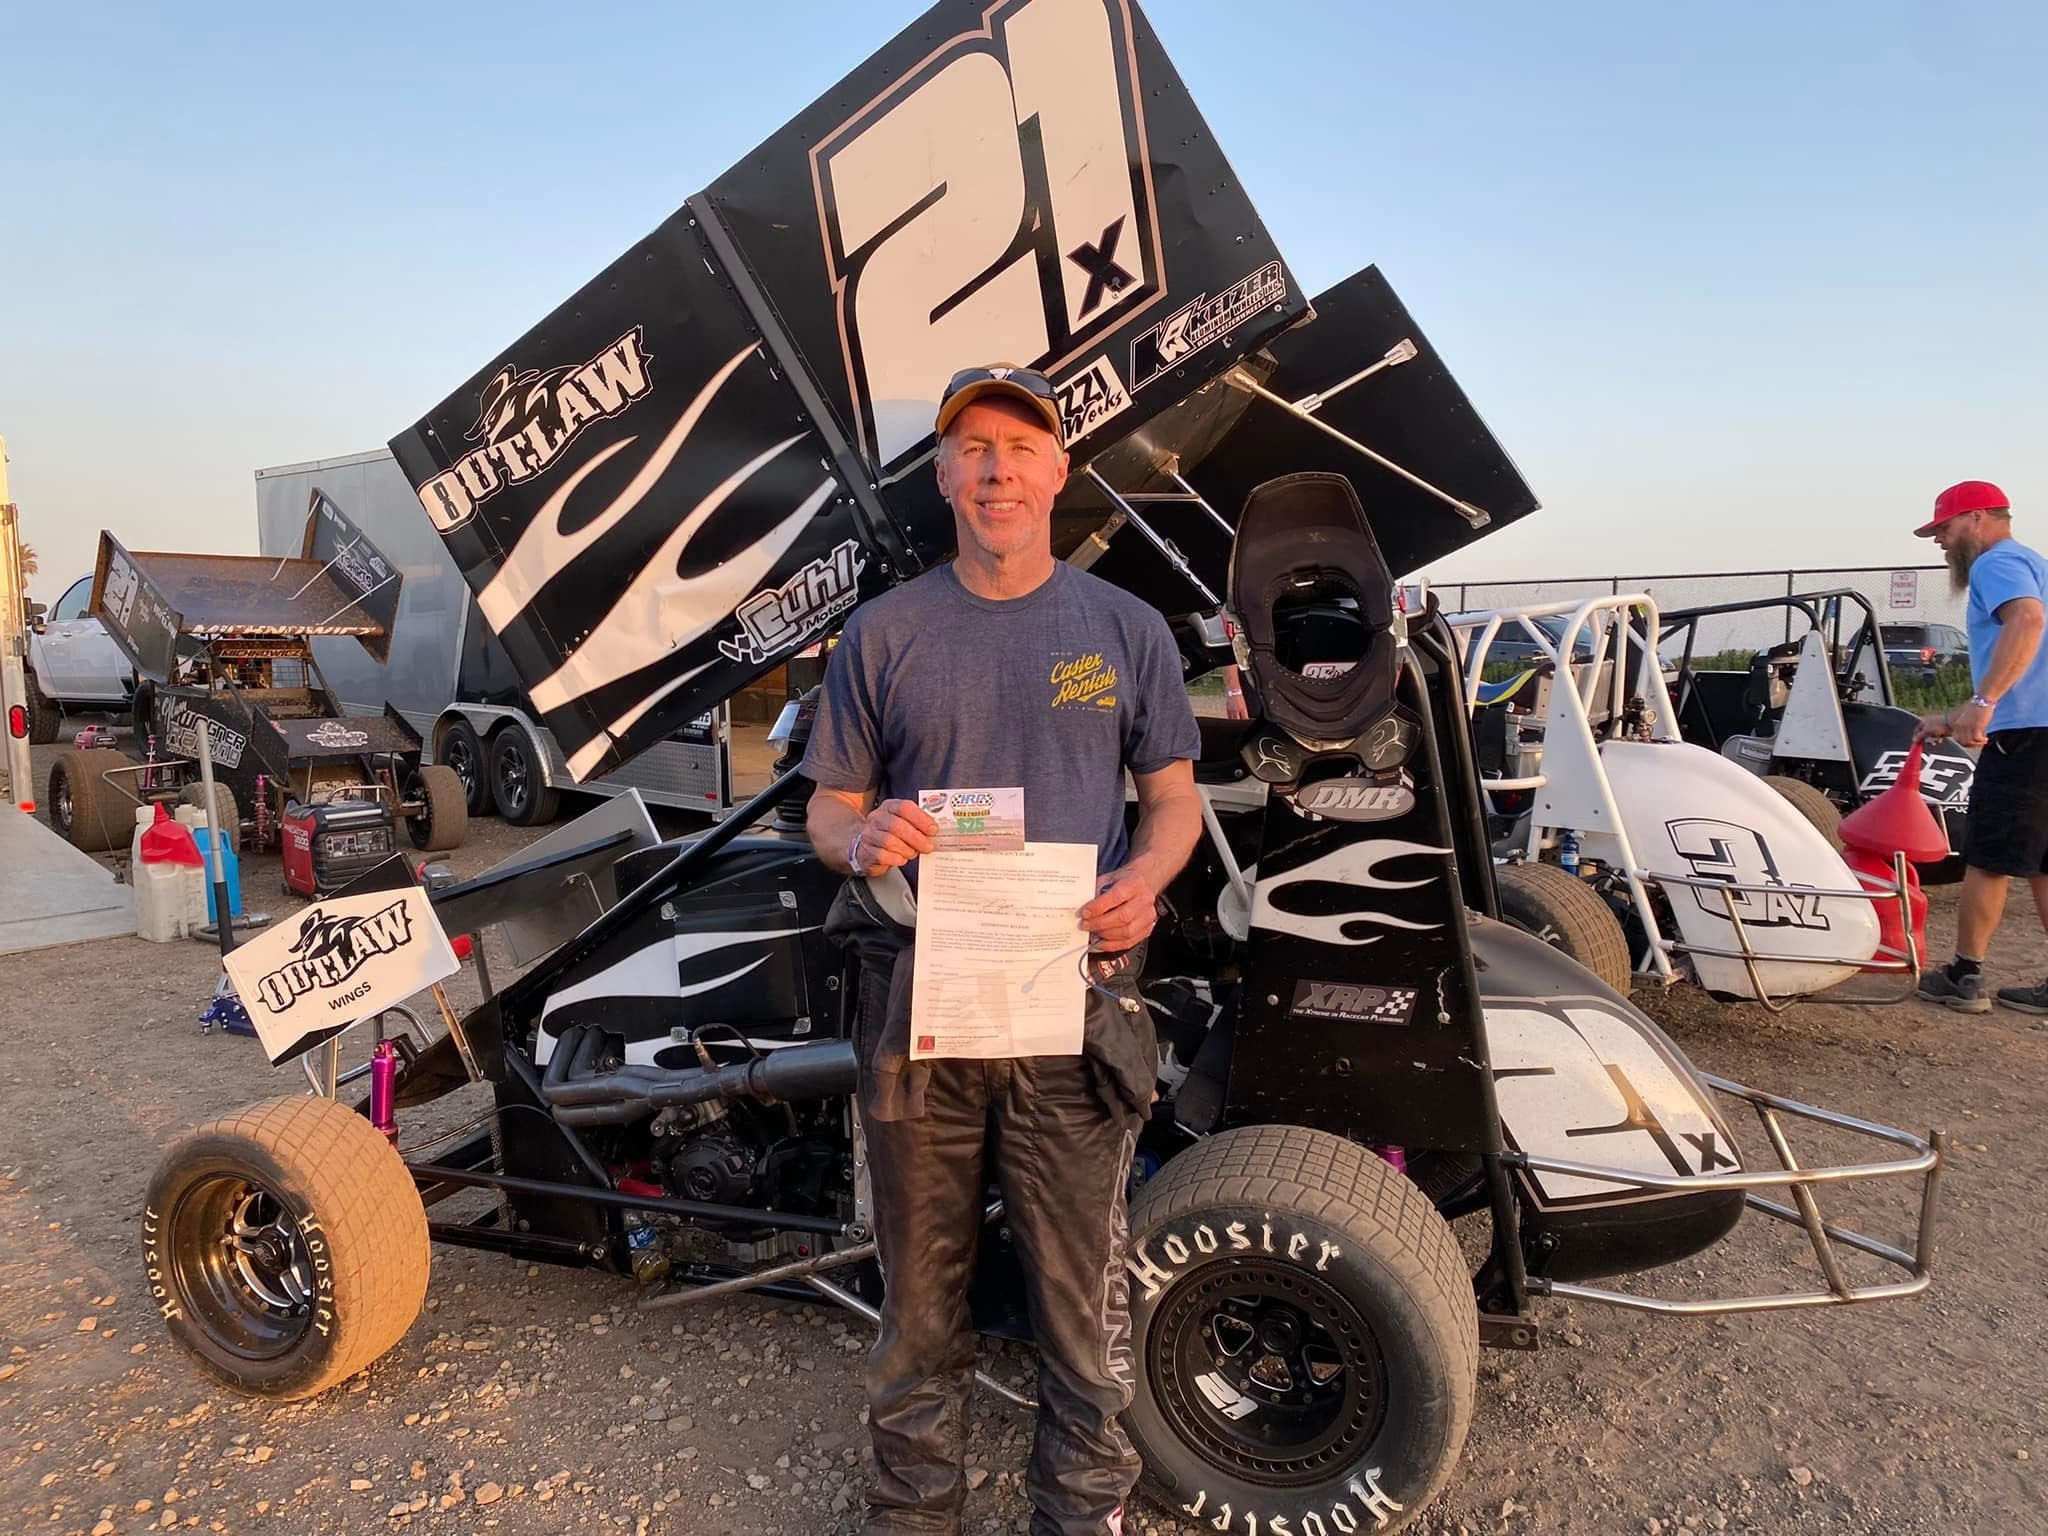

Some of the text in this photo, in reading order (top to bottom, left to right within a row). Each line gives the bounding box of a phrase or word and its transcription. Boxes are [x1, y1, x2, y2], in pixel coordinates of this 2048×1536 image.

[1189, 264, 1279, 334] KEIZER
[1191, 309, 1232, 342] ALUMINUM
[1232, 287, 1265, 316] WHEELS
[418, 328, 649, 532] OUTLAW
[1063, 390, 1122, 440] Works
[804, 596, 856, 631] Motors
[1051, 665, 1117, 707] Rentals
[1309, 786, 1406, 810] DMR
[957, 818, 985, 833] $25
[258, 900, 414, 1014] OUTLAW
[328, 981, 372, 1011] WINGS
[1297, 983, 1387, 1013] XRP
[1339, 1011, 1369, 1020] RACECAR
[143, 1206, 183, 1321] Hoosier
[298, 1211, 335, 1338] Hoosier
[1125, 1212, 1341, 1302] Hoosier
